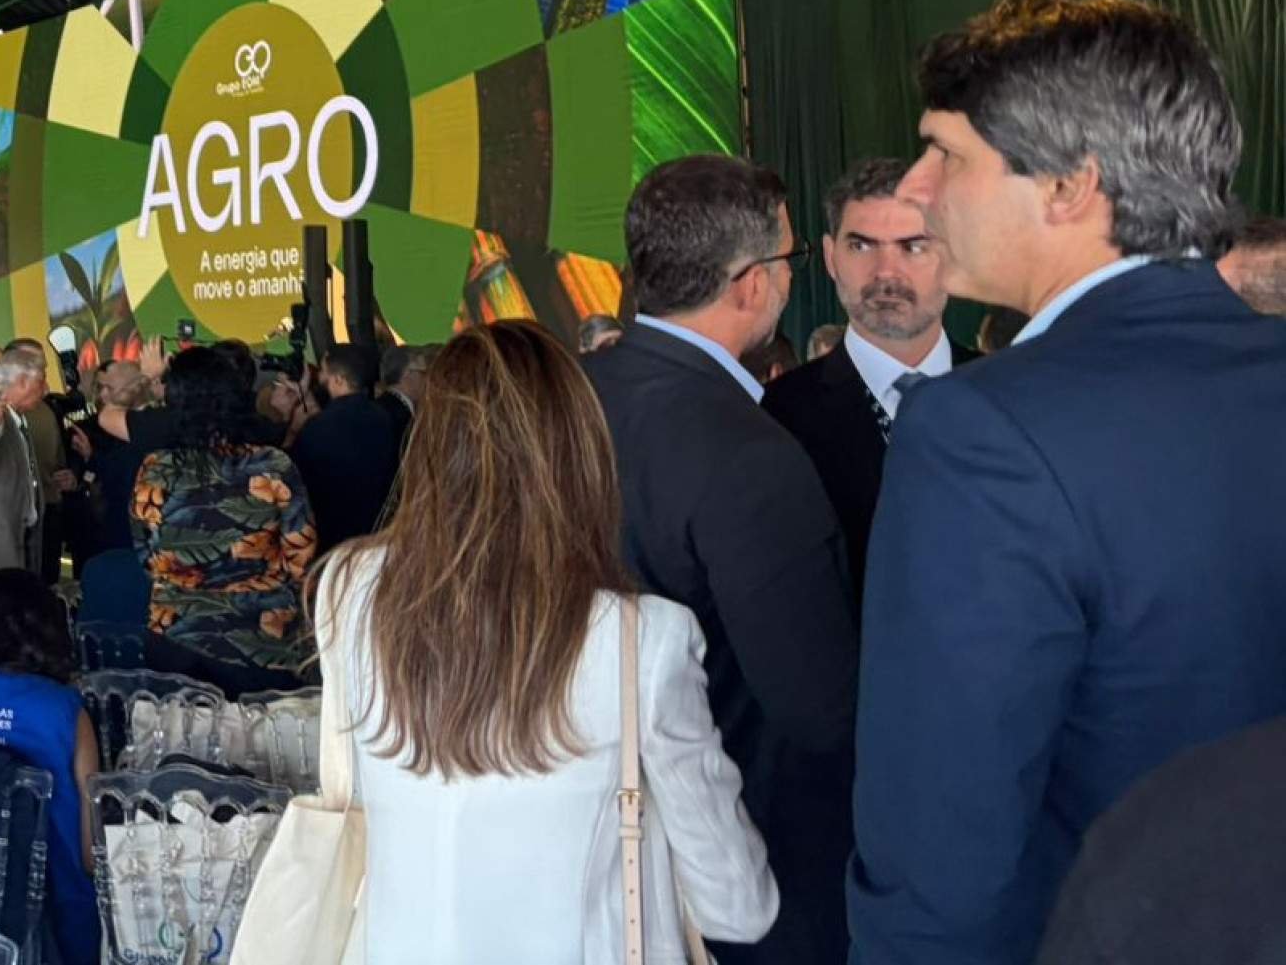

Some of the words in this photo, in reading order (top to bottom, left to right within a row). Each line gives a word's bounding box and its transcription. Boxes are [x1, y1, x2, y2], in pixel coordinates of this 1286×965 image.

[137, 94, 379, 239] AGRO
[200, 250, 212, 272] A
[214, 245, 267, 274] energia
[270, 247, 300, 272] que
[194, 280, 232, 299] move
[235, 279, 246, 297] o
